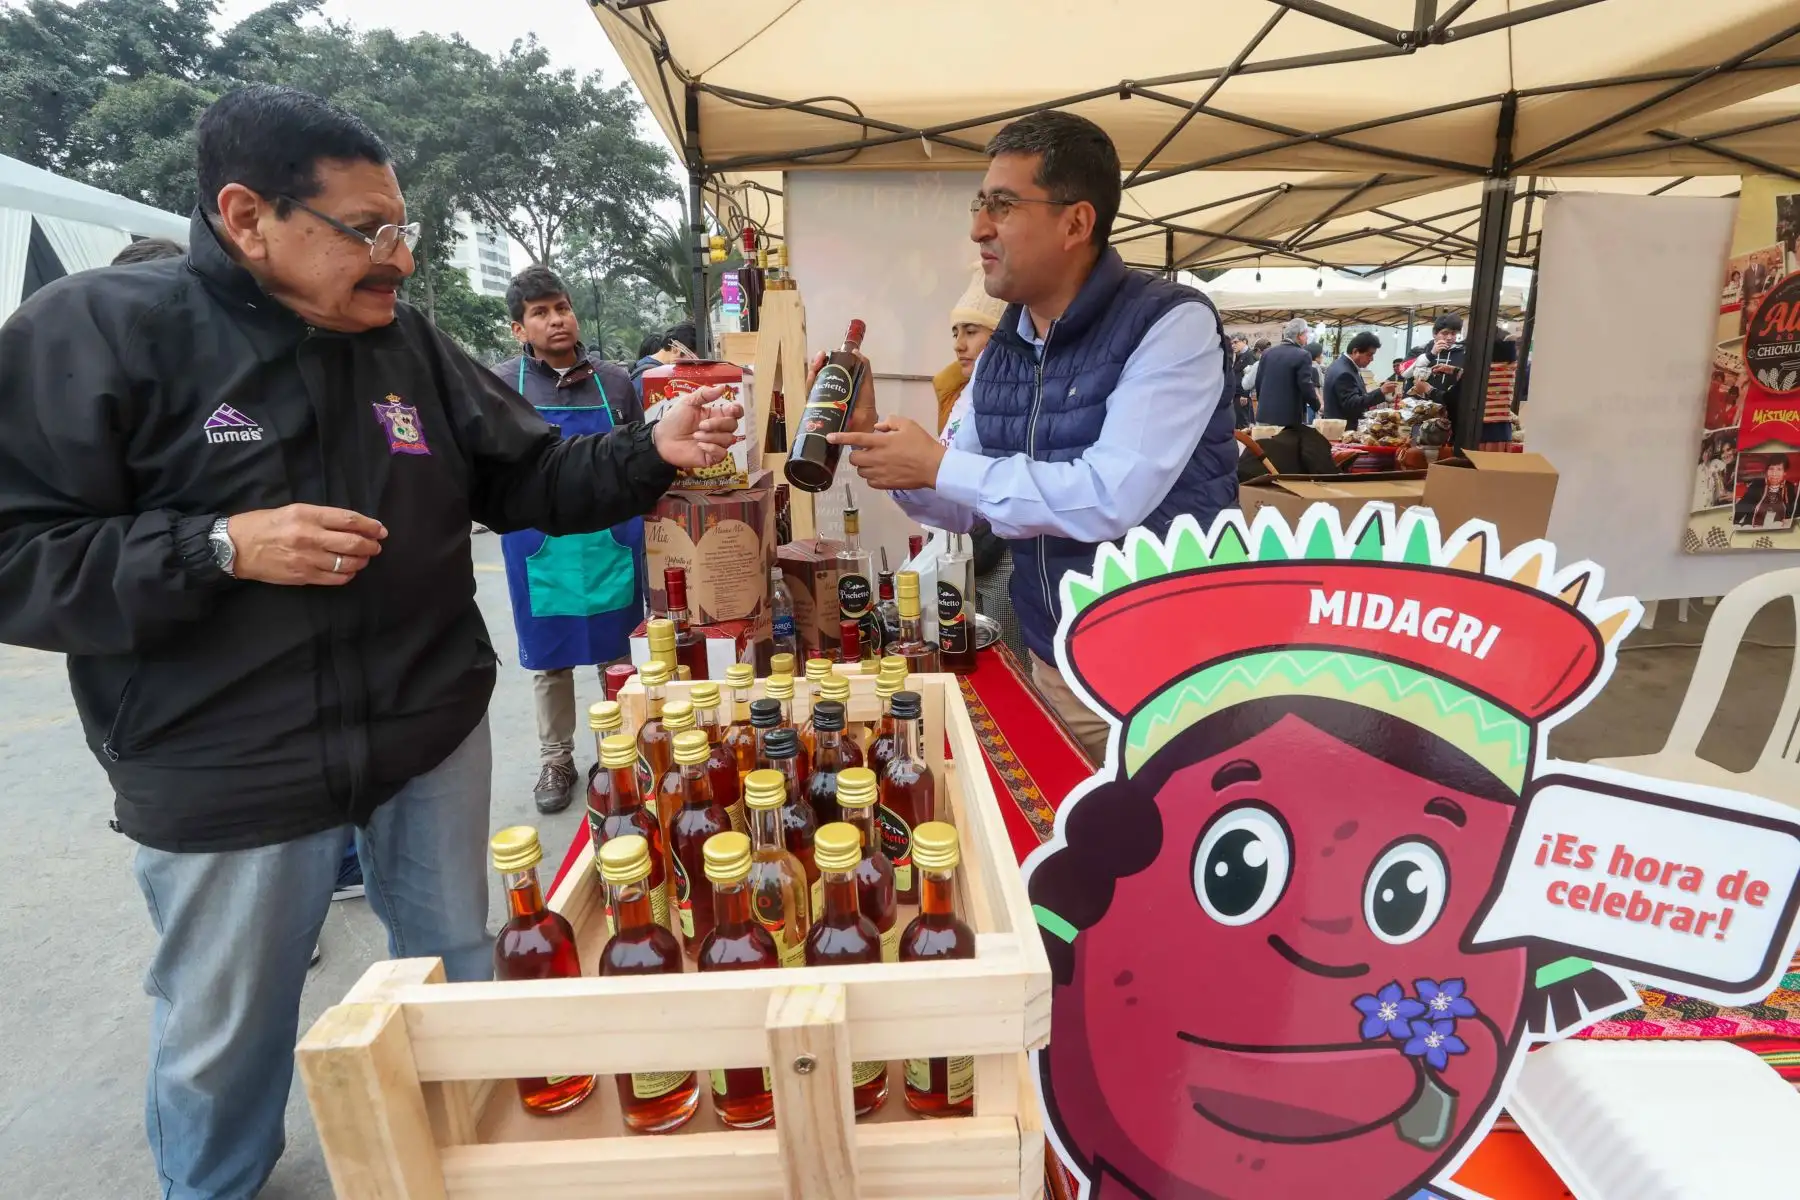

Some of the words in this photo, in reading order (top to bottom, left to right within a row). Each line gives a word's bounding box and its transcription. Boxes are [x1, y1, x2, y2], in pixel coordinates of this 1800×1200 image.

[1308, 588, 1502, 660] MIDAGRI
[1534, 833, 1598, 870] ¡Es
[1607, 843, 1705, 893] hora
[1716, 869, 1771, 907] de
[1546, 879, 1735, 941] celebrar!
